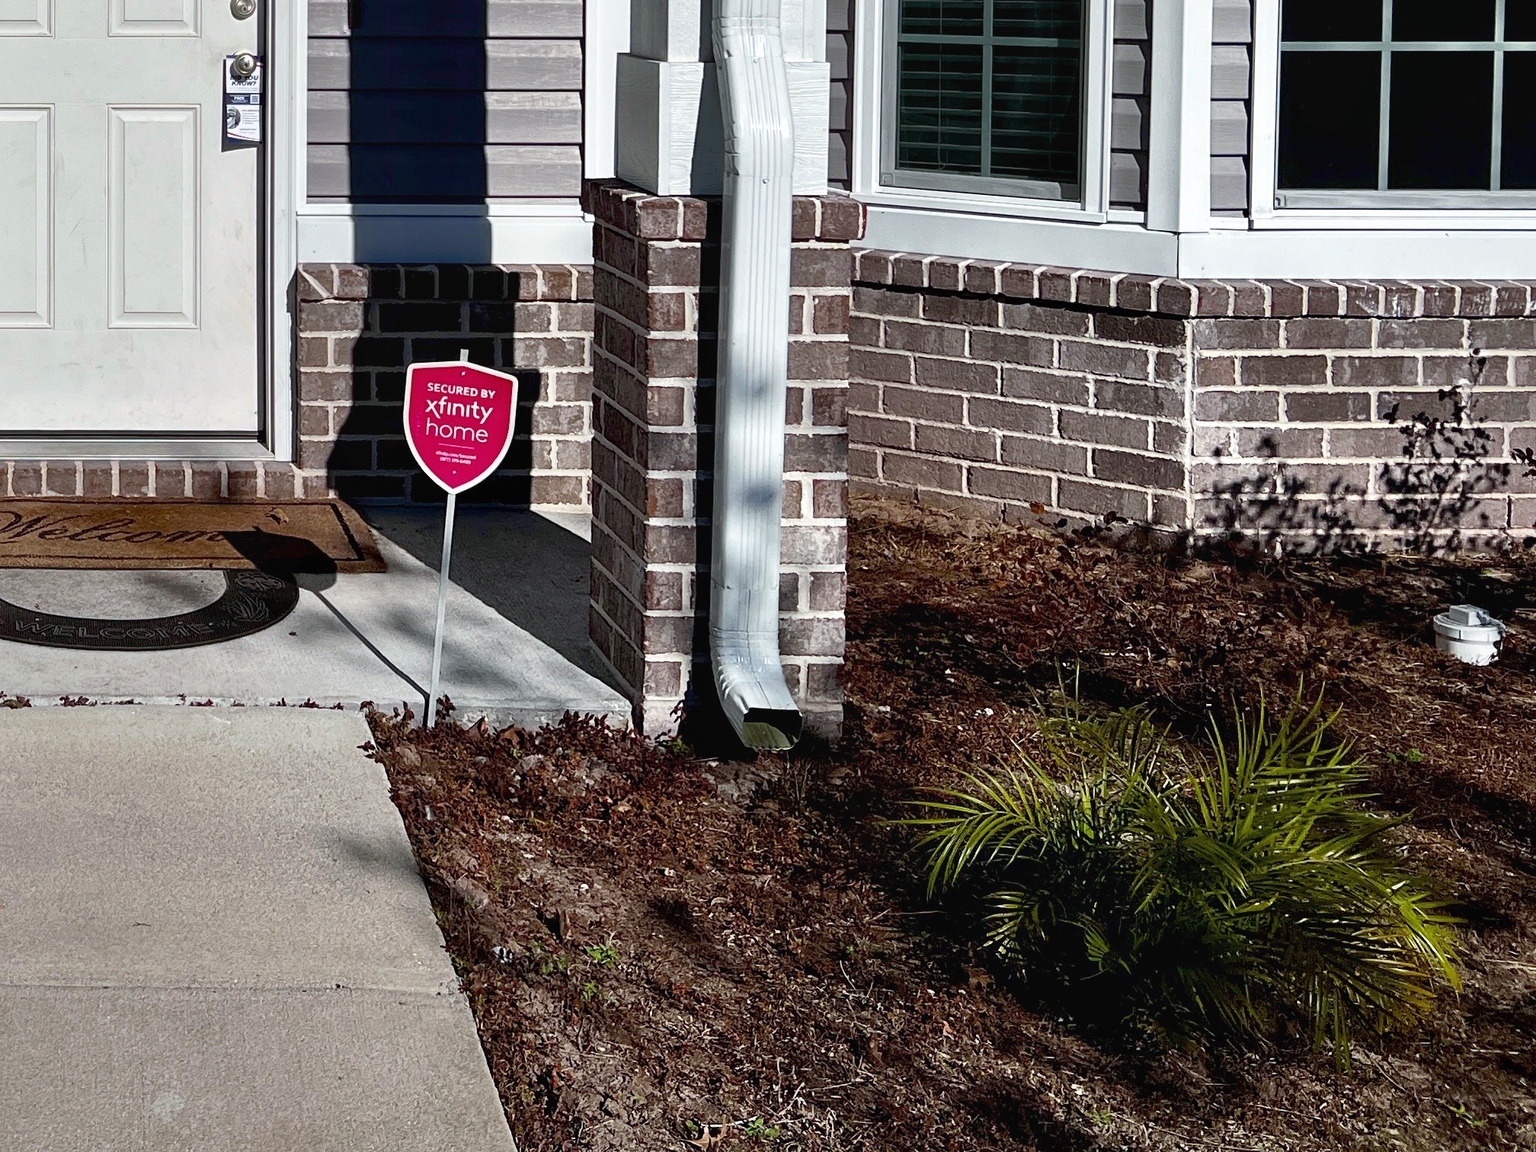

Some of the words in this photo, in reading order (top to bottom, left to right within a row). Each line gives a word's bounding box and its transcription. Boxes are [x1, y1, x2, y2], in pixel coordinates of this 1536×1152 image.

[427, 382, 478, 397] SECURED
[480, 389, 496, 399] BY
[425, 395, 494, 424] xfinity
[425, 417, 489, 443] home
[15, 619, 215, 640] WELCOME
